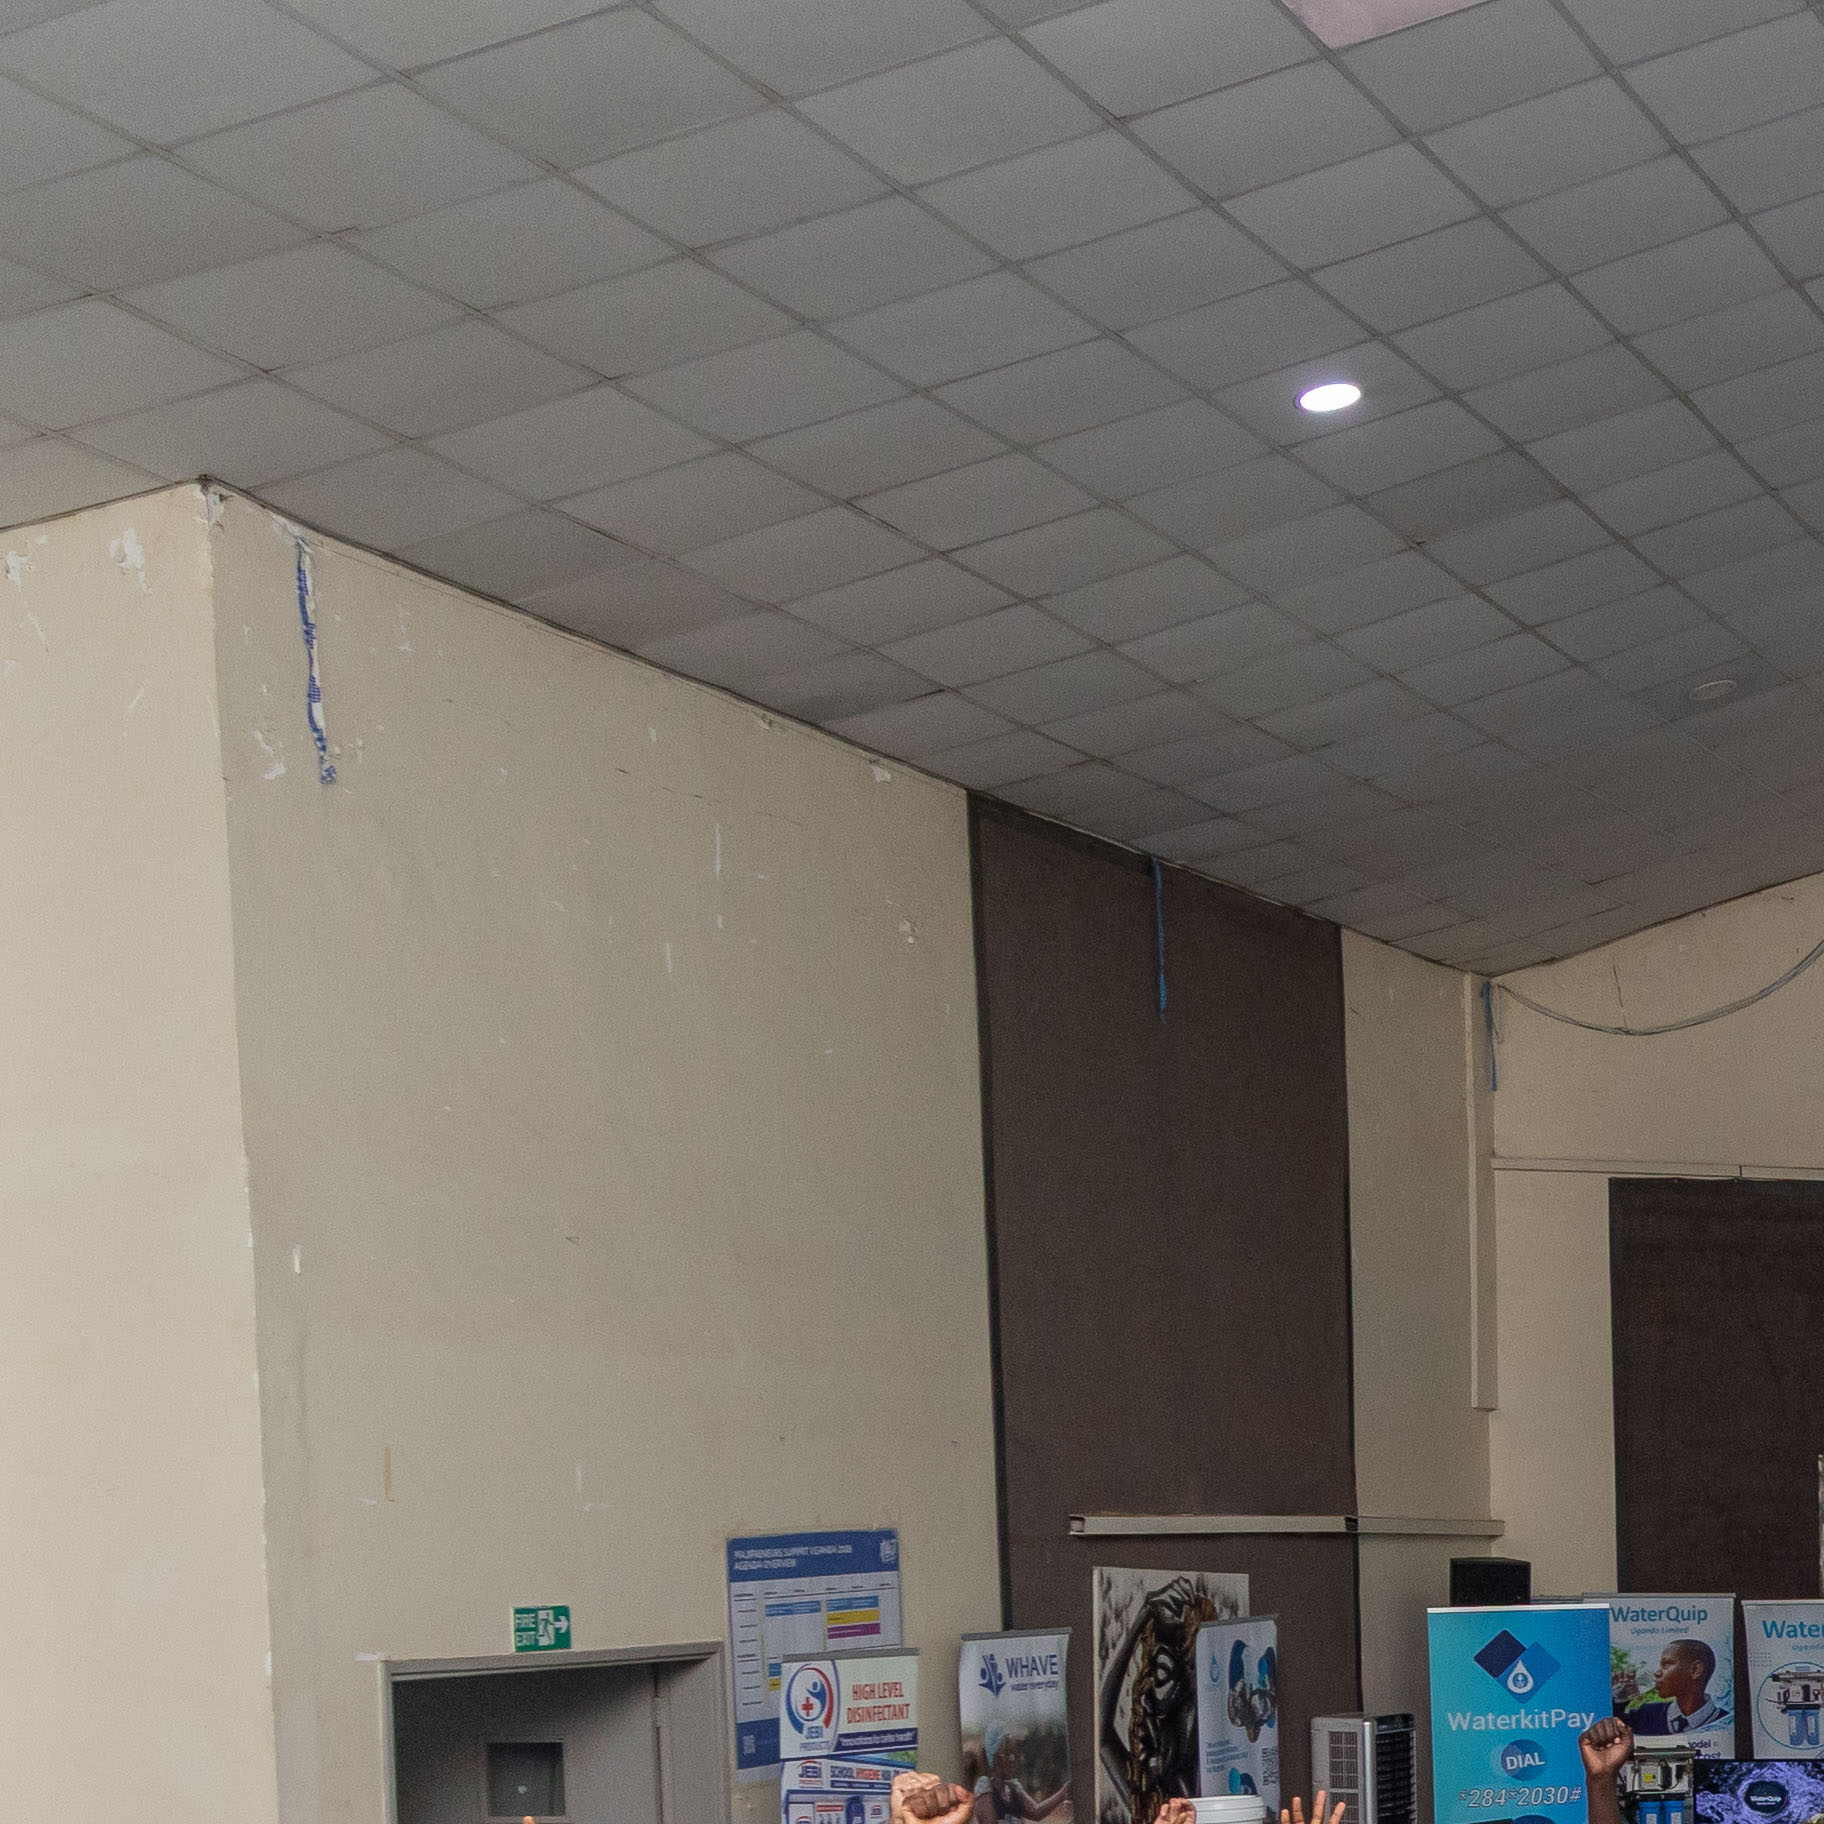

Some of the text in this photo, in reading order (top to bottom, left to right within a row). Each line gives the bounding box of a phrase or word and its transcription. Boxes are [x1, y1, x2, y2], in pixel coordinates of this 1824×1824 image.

[514, 1613, 536, 1628] FIRE
[1611, 1606, 1708, 1625] WaterQuip
[516, 1631, 536, 1647] EXIT
[1631, 1625, 1689, 1637] Uganda Limited
[1005, 1654, 1058, 1679] WHAVE
[852, 1682, 904, 1701] HIGH LEVEL
[846, 1703, 910, 1724] DISINFECTANT
[1447, 1708, 1595, 1732] WaterkitPay
[1506, 1752, 1546, 1770] DIAL
